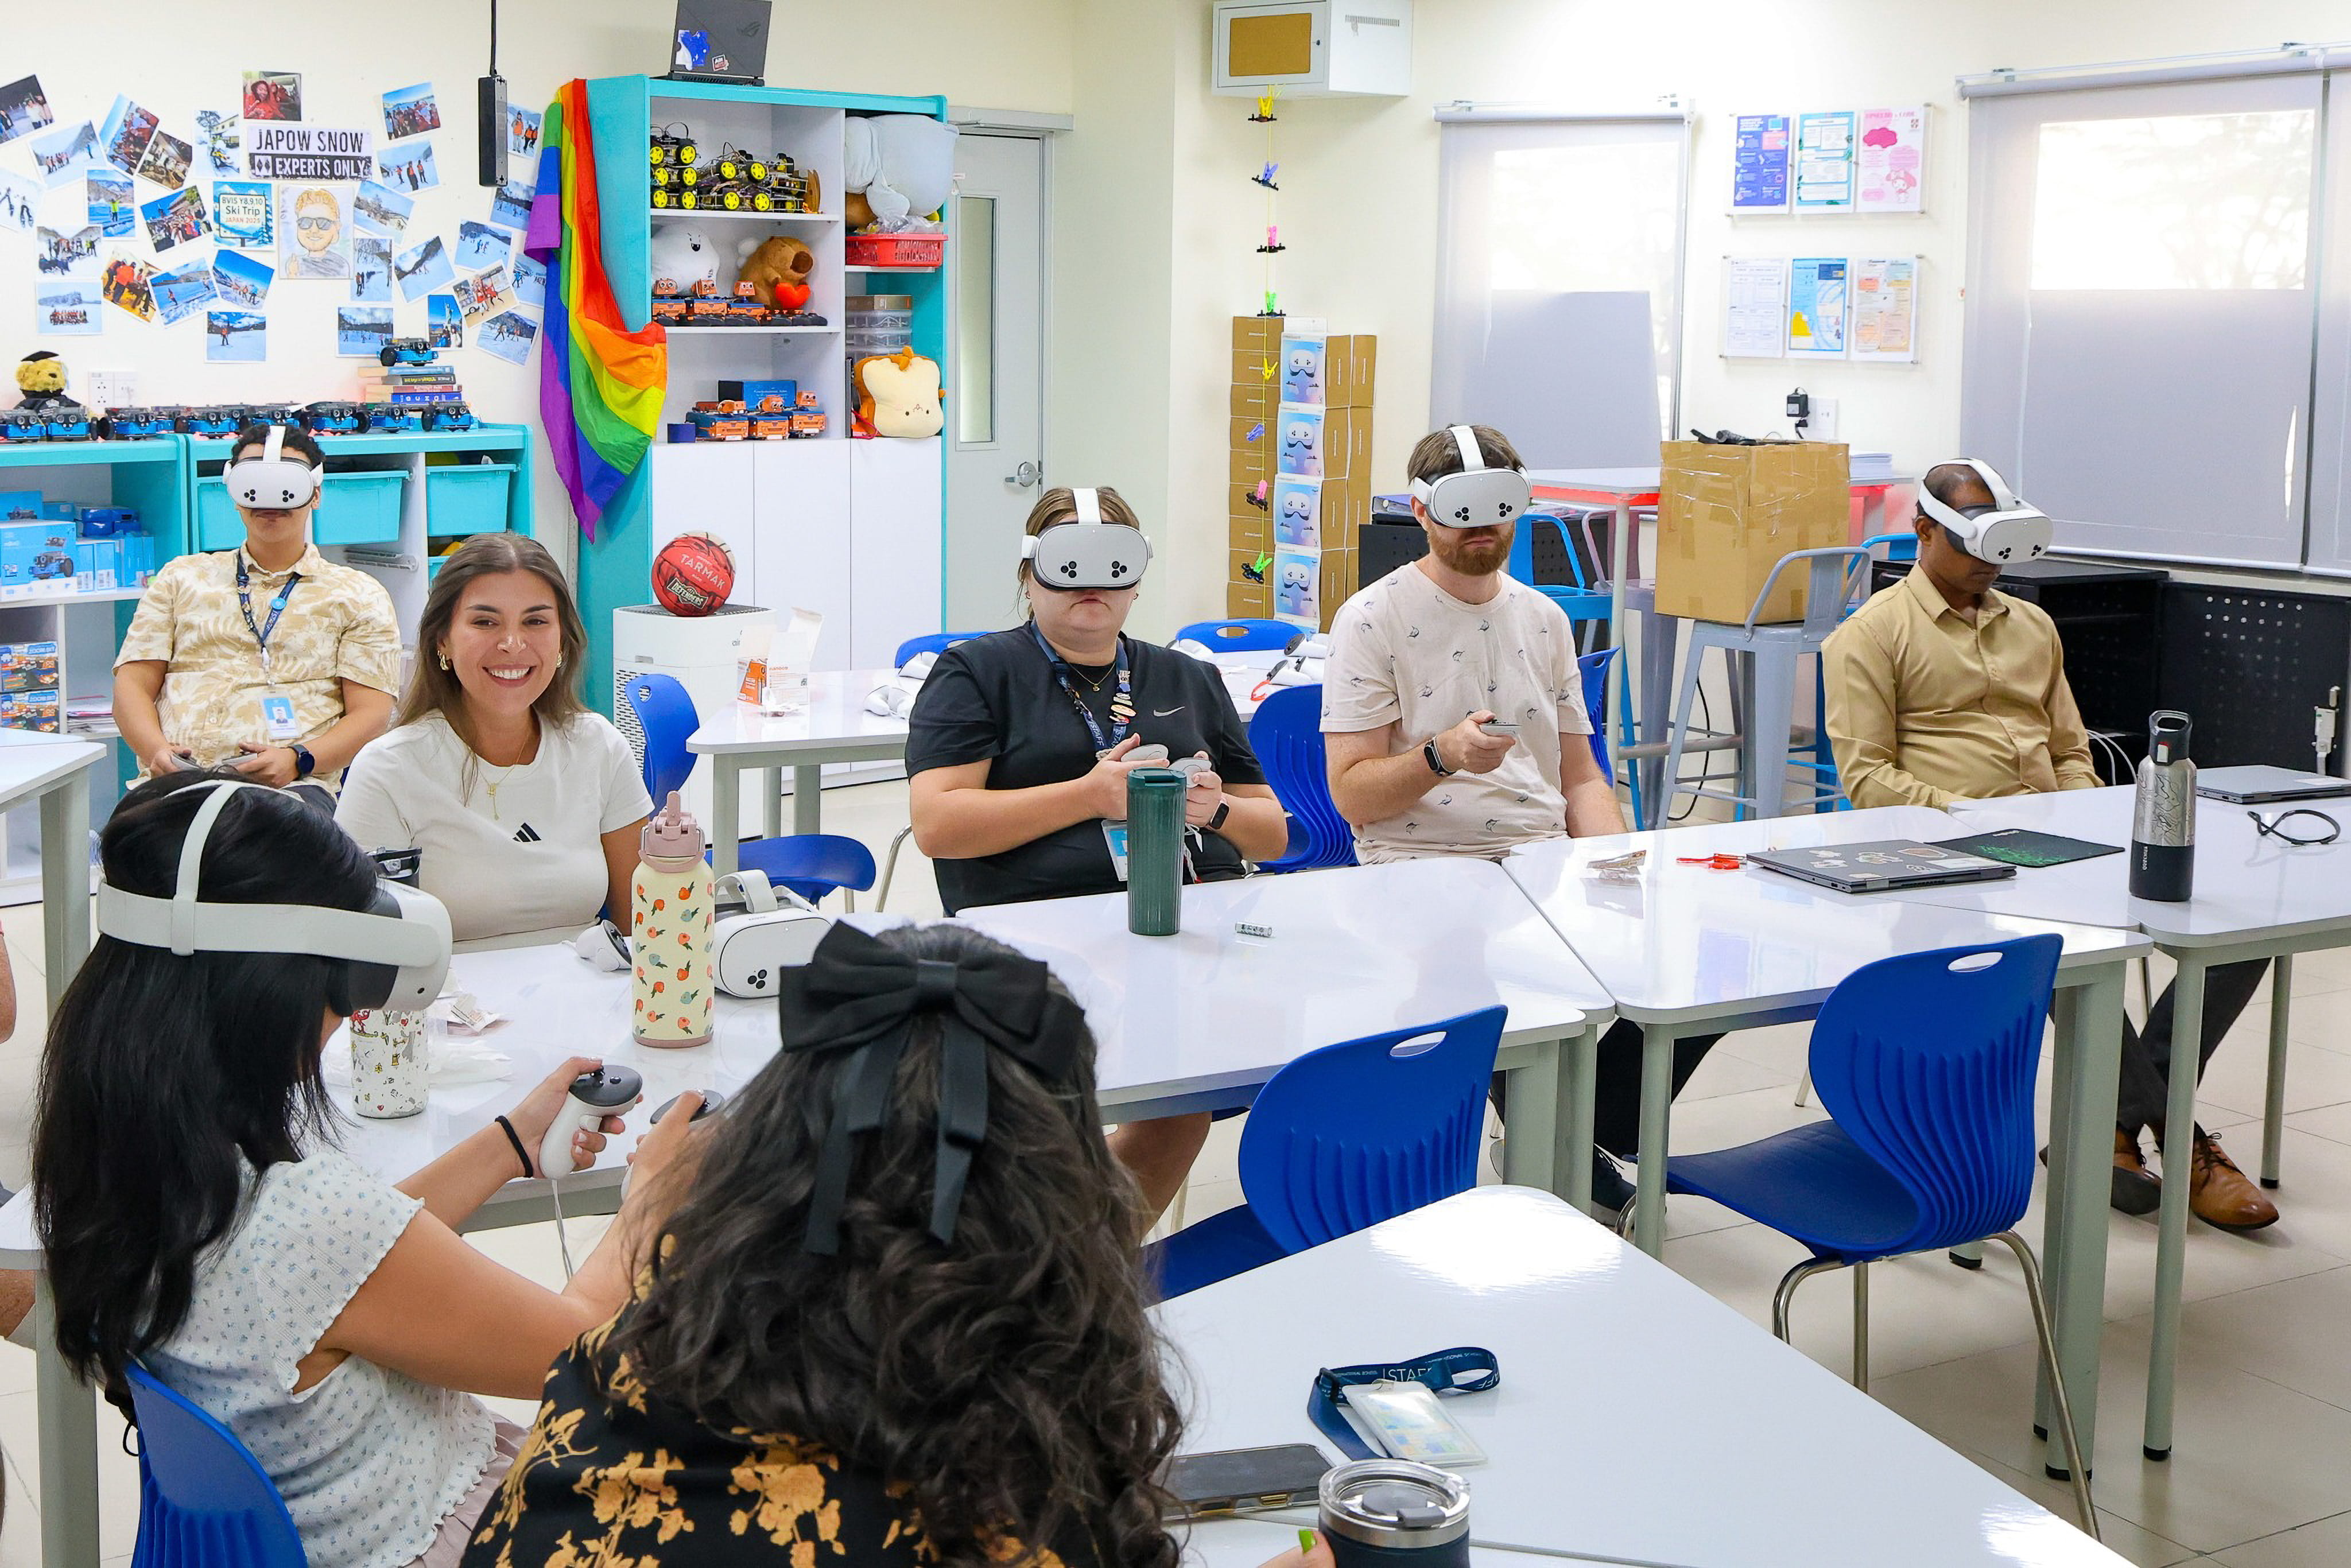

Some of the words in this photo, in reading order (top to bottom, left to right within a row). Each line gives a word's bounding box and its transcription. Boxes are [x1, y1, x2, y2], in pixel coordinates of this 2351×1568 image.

[256, 129, 311, 152] JAPOW
[317, 130, 364, 153] SNOW
[275, 157, 331, 176] EXPERTS
[333, 159, 366, 178] ONLY
[222, 196, 238, 204] BVIS
[226, 205, 239, 215] Ski
[242, 206, 260, 217] Trip
[681, 553, 726, 591] TARMAK
[671, 581, 704, 606] DEFENDERS
[1090, 723, 1104, 746] STAFF
[1388, 1367, 1433, 1383] STAF
